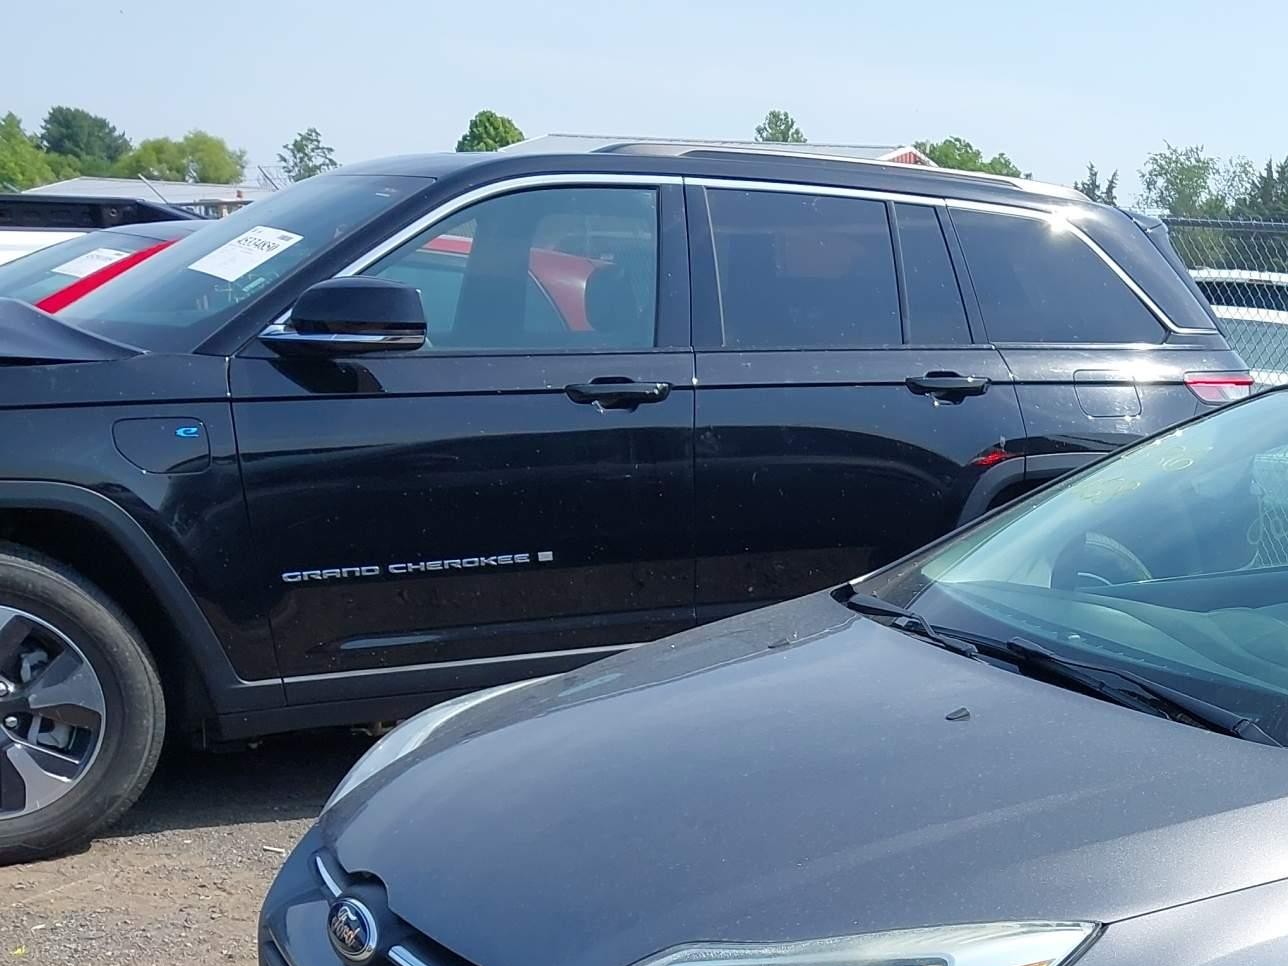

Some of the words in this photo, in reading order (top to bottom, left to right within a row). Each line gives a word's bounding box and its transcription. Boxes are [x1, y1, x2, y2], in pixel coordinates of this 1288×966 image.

[281, 565, 380, 583] GRAND
[387, 553, 531, 574] CHEROKEE
[330, 905, 361, 947] Ford
